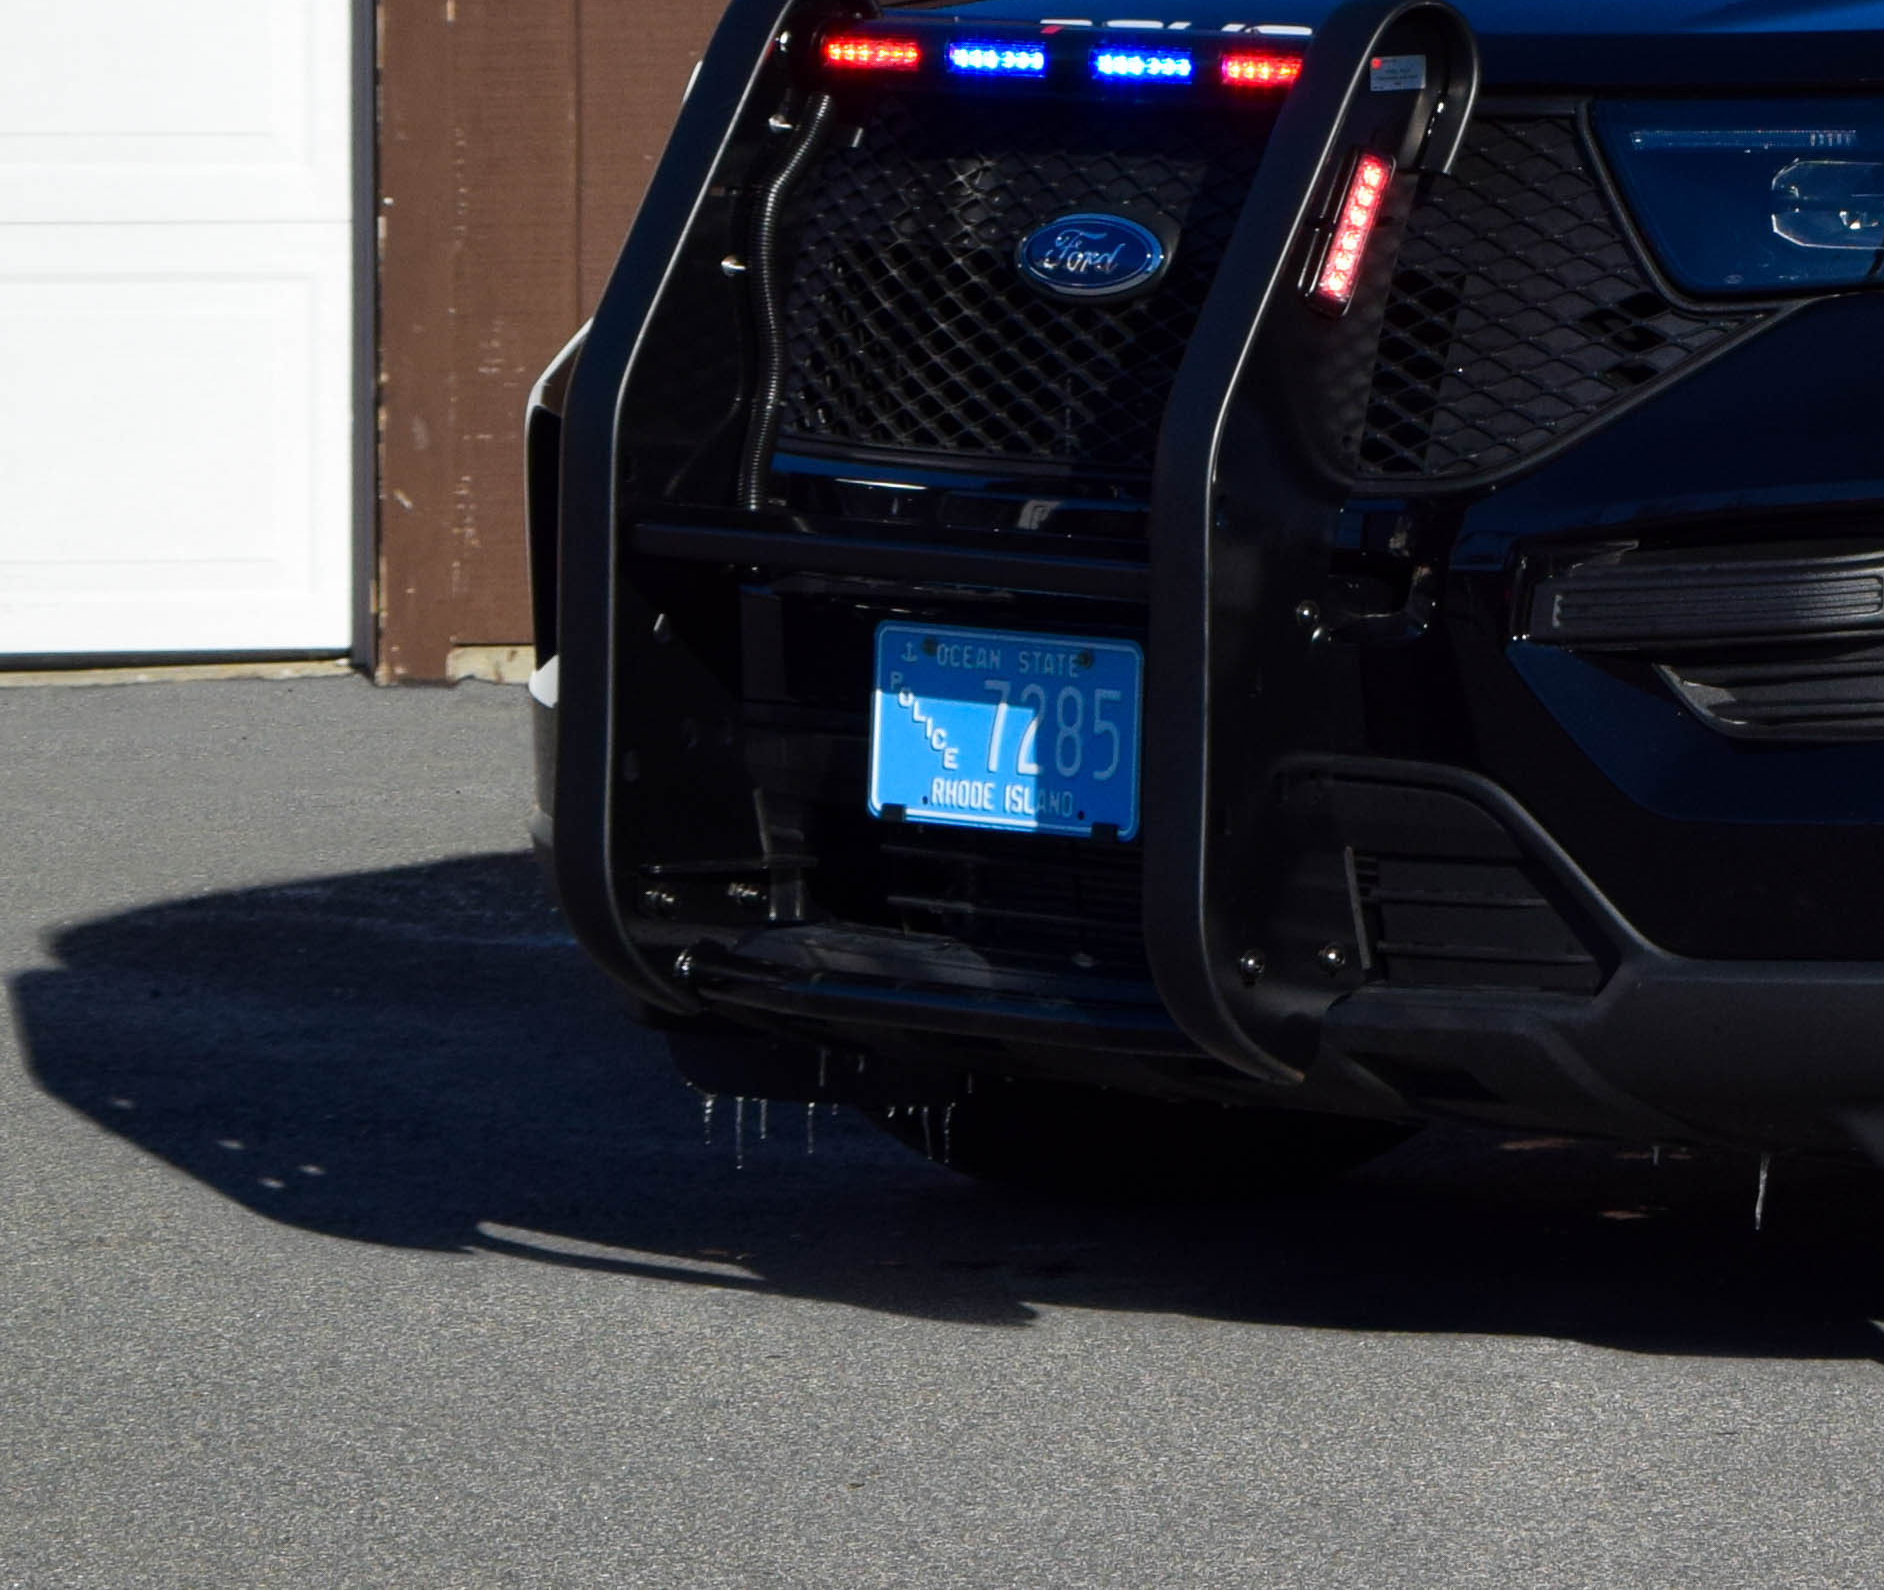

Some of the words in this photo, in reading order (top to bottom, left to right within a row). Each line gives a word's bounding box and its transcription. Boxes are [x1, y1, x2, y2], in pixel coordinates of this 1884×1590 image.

[1043, 228, 1127, 273] Ford
[936, 642, 1001, 671] OCEAN
[1018, 649, 1080, 679] STATE
[889, 670, 960, 771] POLICE
[983, 678, 1122, 781] 7285
[931, 776, 996, 811] RHODE
[1003, 783, 1074, 818] ISLAND
